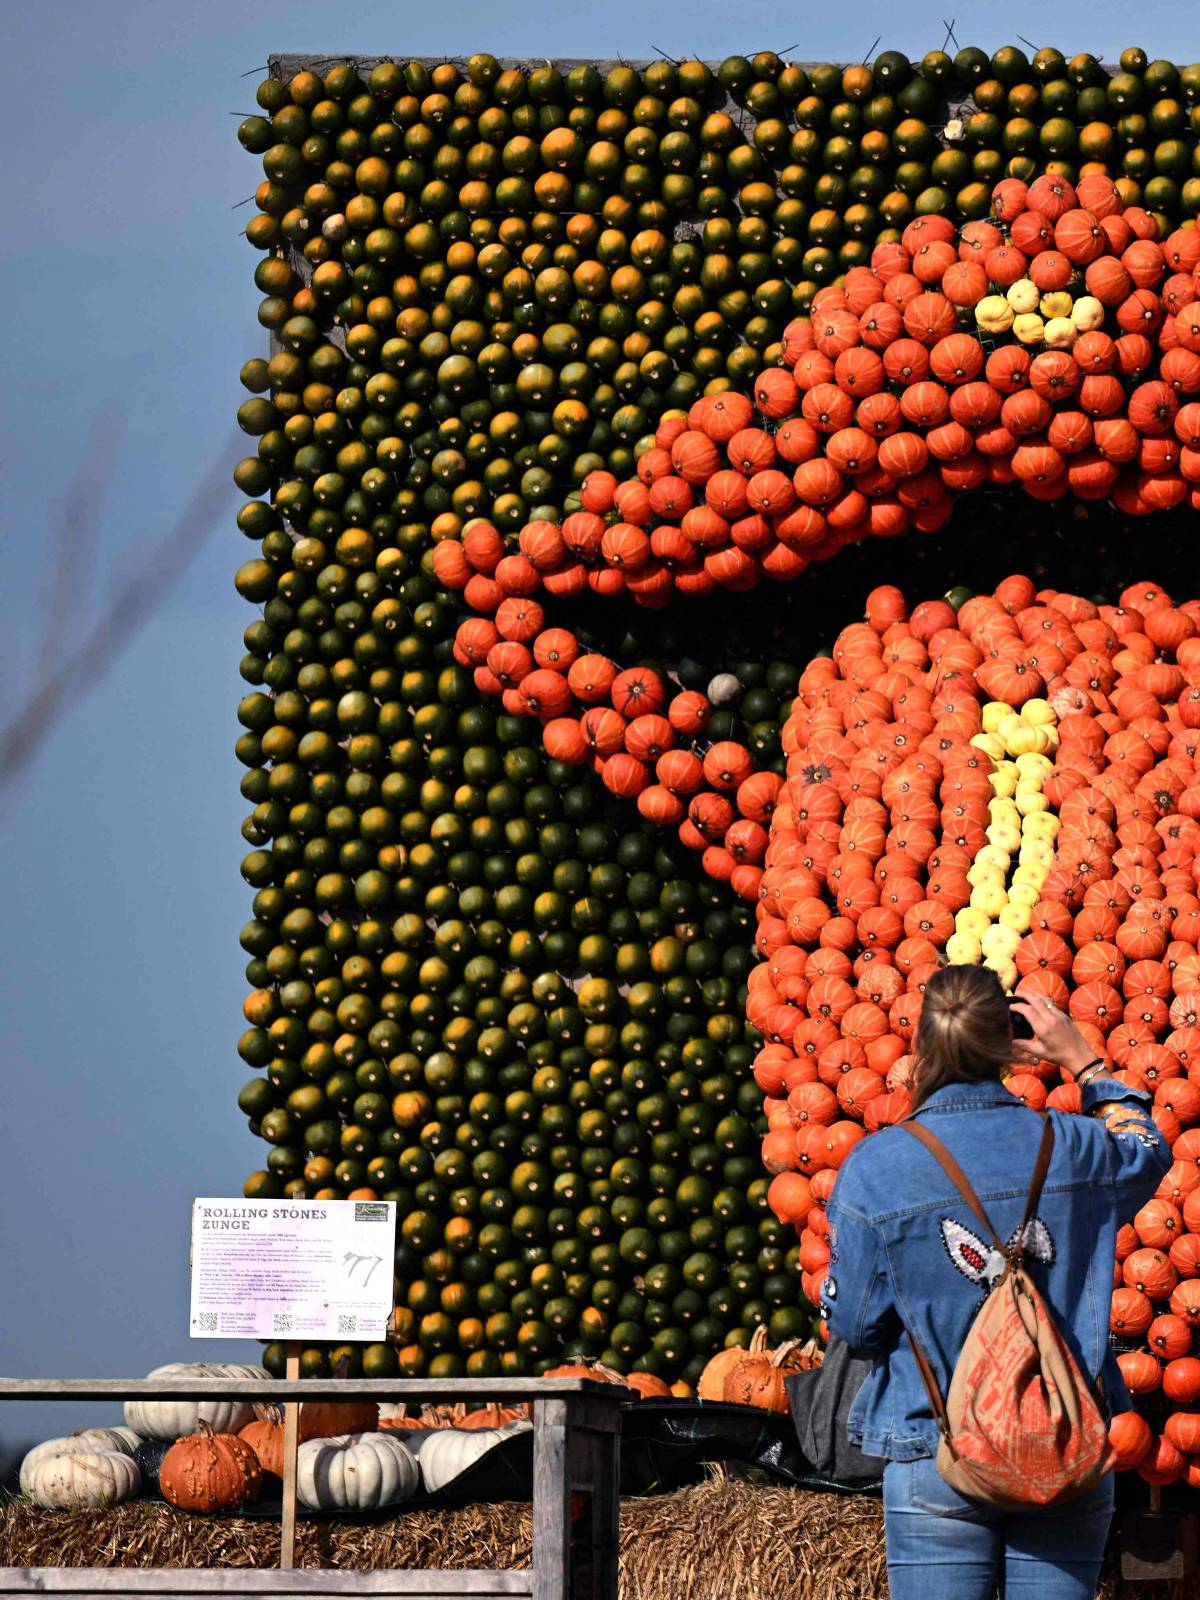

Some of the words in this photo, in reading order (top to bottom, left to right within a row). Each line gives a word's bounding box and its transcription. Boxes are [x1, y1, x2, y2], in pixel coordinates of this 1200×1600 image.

[203, 1208, 268, 1219] ROLLING
[272, 1208, 327, 1220] STONES
[202, 1220, 250, 1230] ZUNGE
